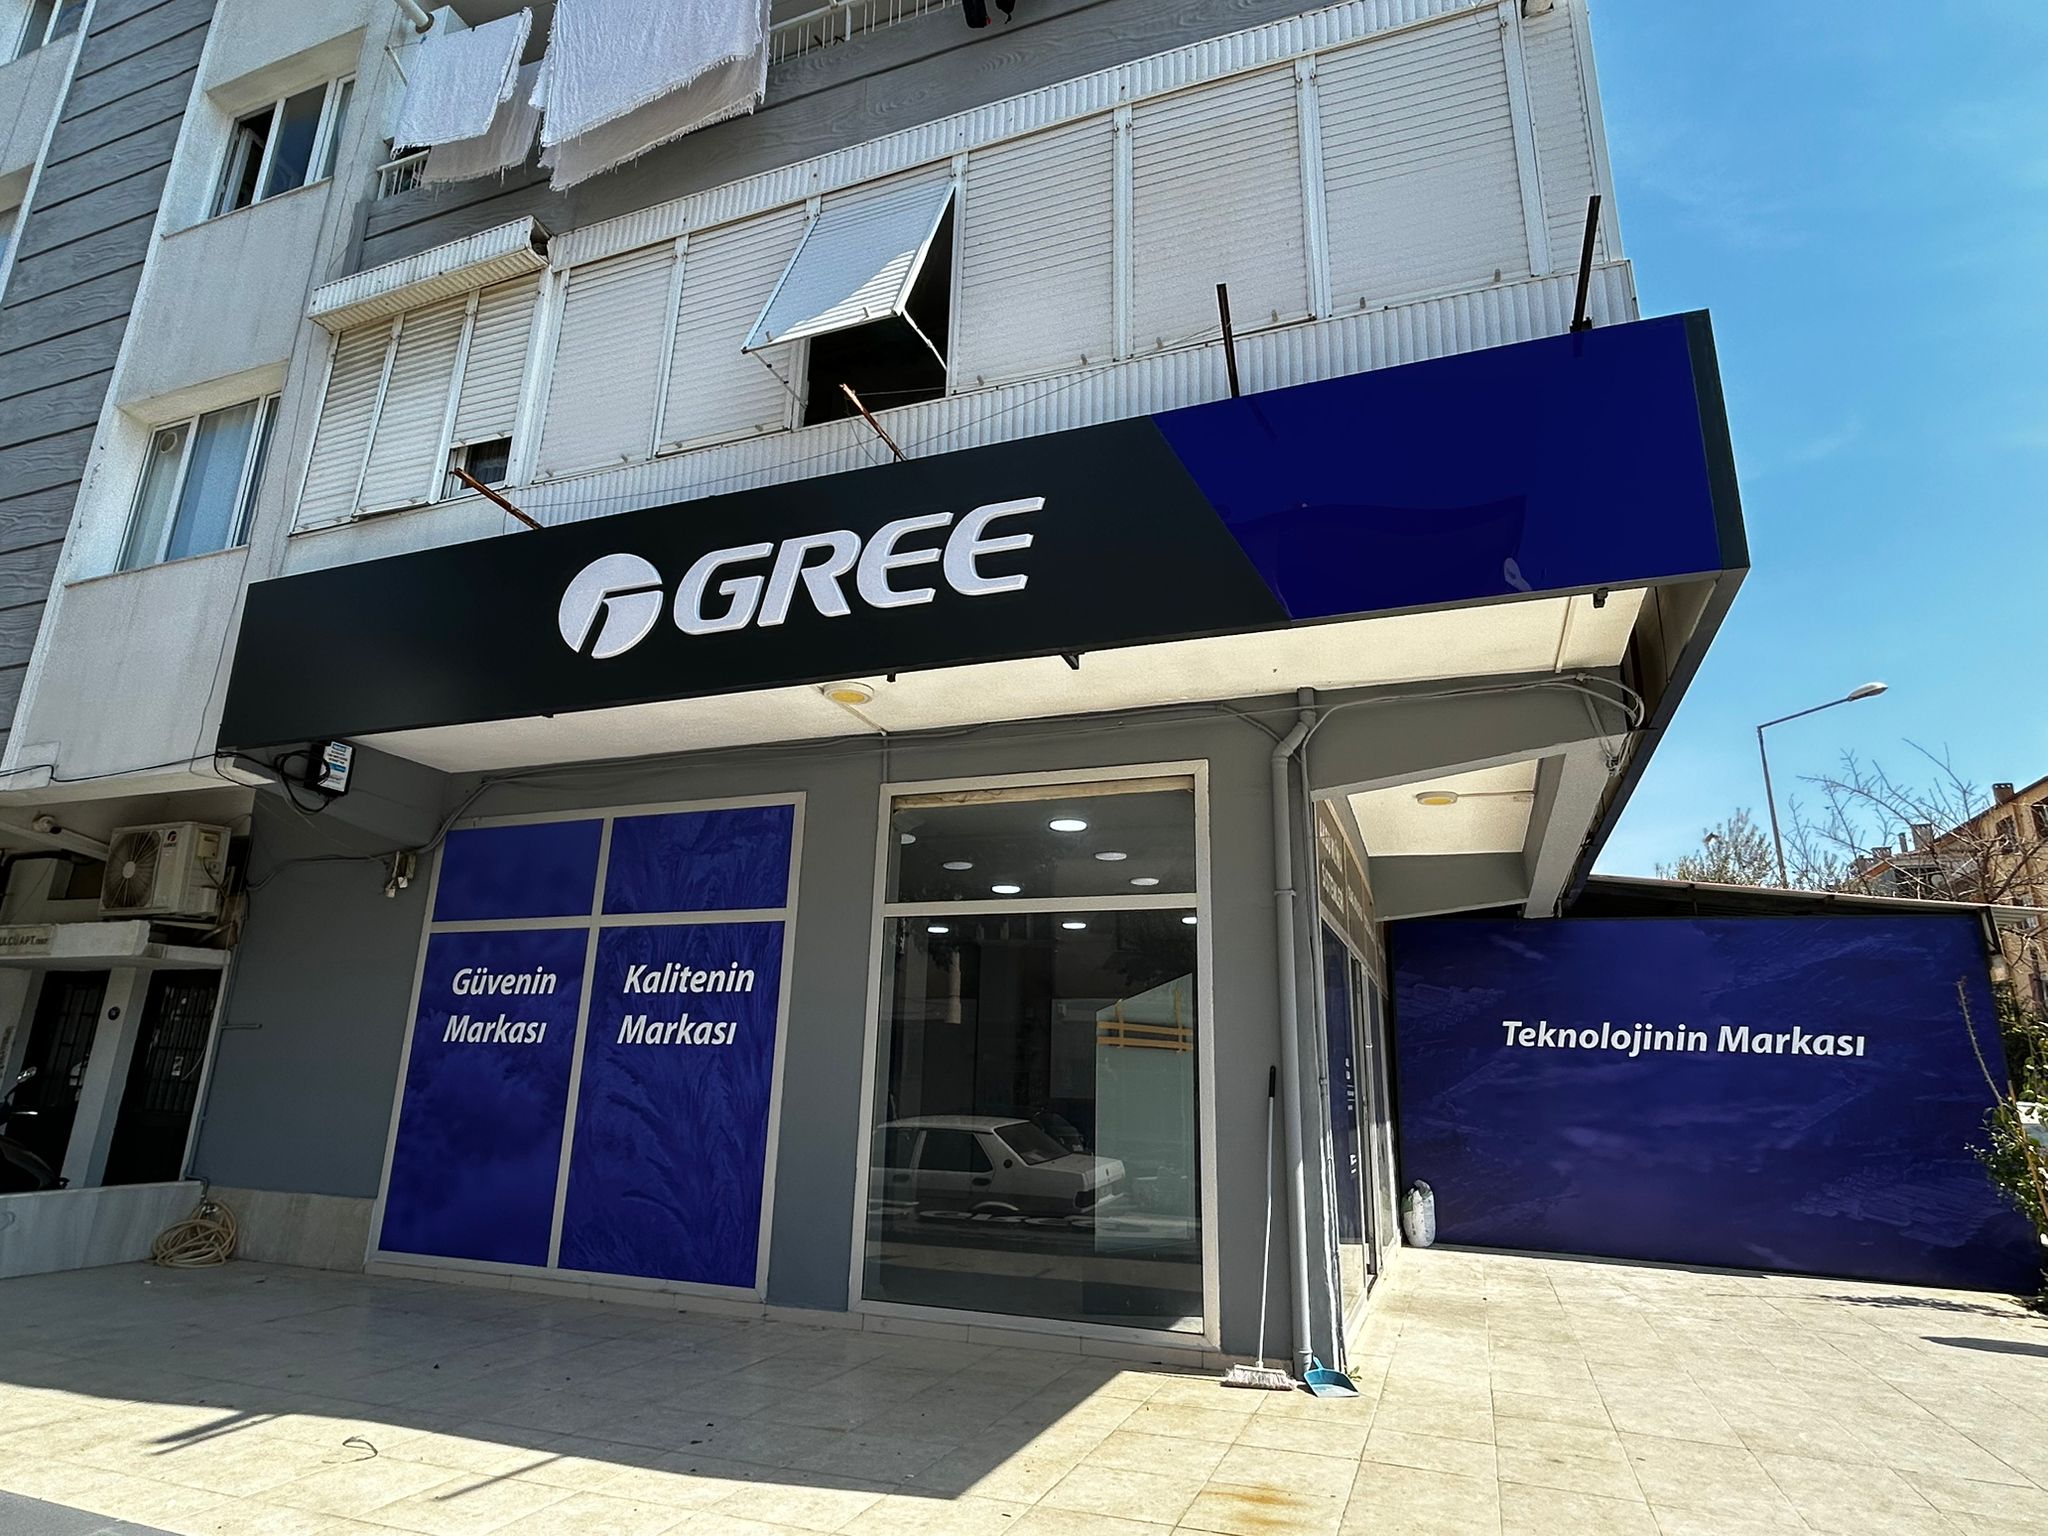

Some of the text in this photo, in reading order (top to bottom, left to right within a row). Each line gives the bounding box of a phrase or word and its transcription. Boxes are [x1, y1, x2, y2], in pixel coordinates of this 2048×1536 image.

[673, 496, 1046, 636] GREE
[452, 966, 557, 996] Güvenin
[623, 961, 755, 994] Kalitenin
[442, 1013, 547, 1044] Markası
[616, 1013, 737, 1045] Markası
[1502, 1020, 1866, 1058] Teknolojinin Markası
